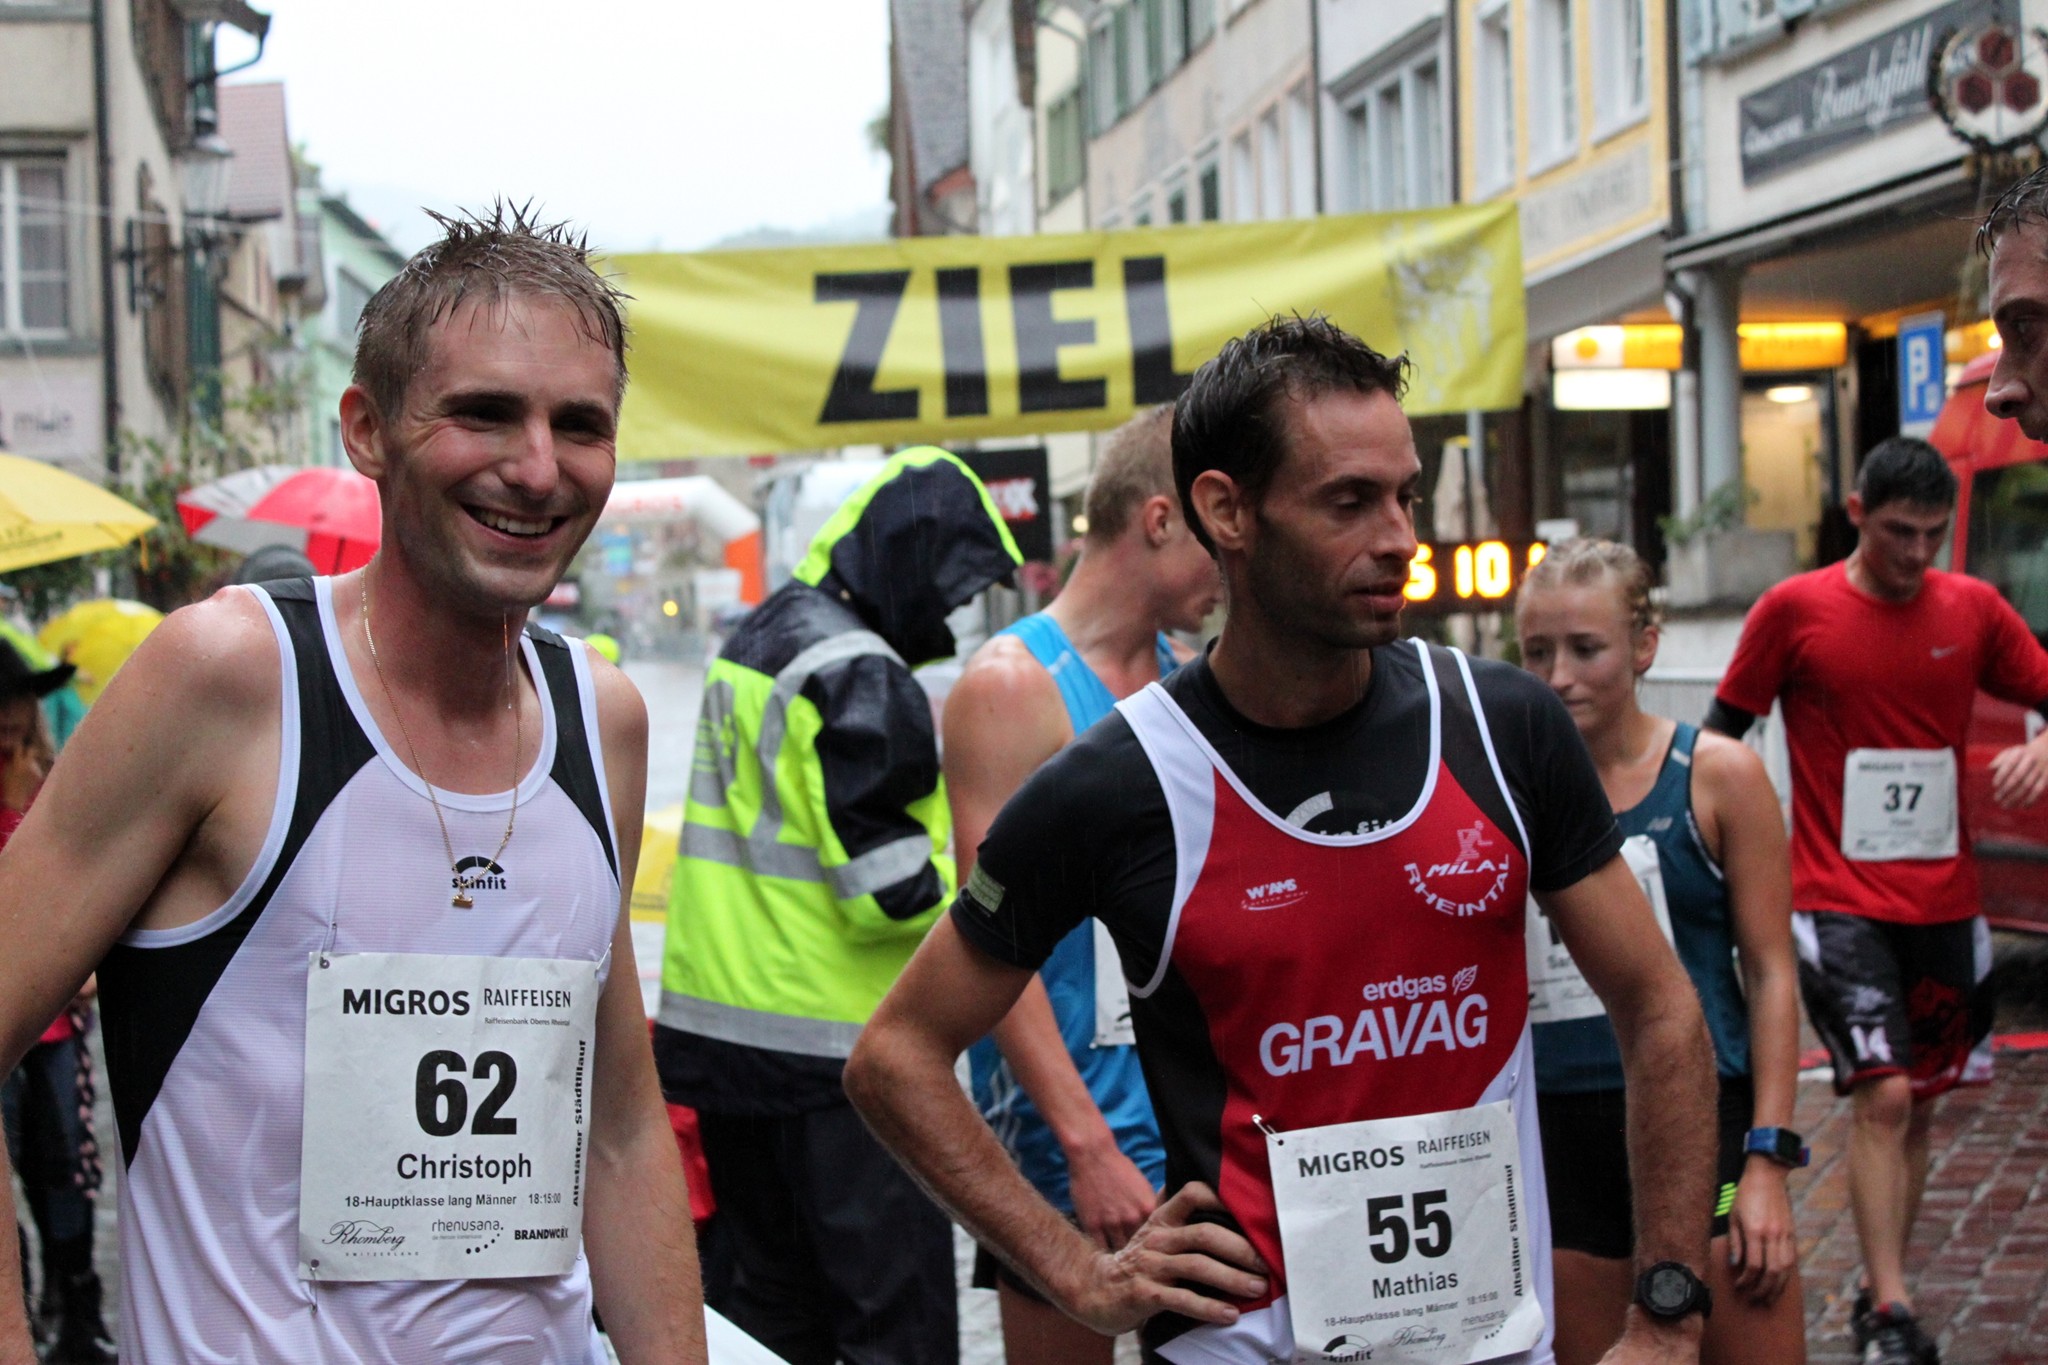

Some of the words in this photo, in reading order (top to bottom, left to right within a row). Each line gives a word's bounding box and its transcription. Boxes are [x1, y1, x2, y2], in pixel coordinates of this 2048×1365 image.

[814, 254, 1200, 424] ZIEL
[1907, 335, 1930, 411] P
[1455, 541, 1511, 599] 10
[1884, 782, 1924, 812] 37
[452, 876, 506, 890] skinfit
[1426, 859, 1497, 878] MILA
[1404, 853, 1509, 917] RHEINTAL
[343, 989, 470, 1016] MIGROS
[484, 988, 571, 1008] RAIFFEISEN
[1362, 974, 1447, 1001] erdgas
[1259, 994, 1488, 1077] GRAVAG
[415, 1049, 517, 1137] 62
[1418, 1130, 1491, 1154] RAIFFEISEN
[397, 1153, 532, 1184] Christoph
[1298, 1146, 1405, 1178] MIGROS
[345, 1195, 445, 1209] 18-Hauptklasse
[448, 1195, 472, 1208] lang
[475, 1193, 517, 1205] Männer
[528, 1193, 561, 1204] 18:15:00
[322, 1220, 406, 1251] Rhomberg
[1367, 1189, 1453, 1264] 55
[1372, 1271, 1459, 1299] Mathias
[1324, 1306, 1401, 1328] 18-Hauptklasse
[1402, 1305, 1424, 1318] lang
[1426, 1300, 1459, 1314] Männer
